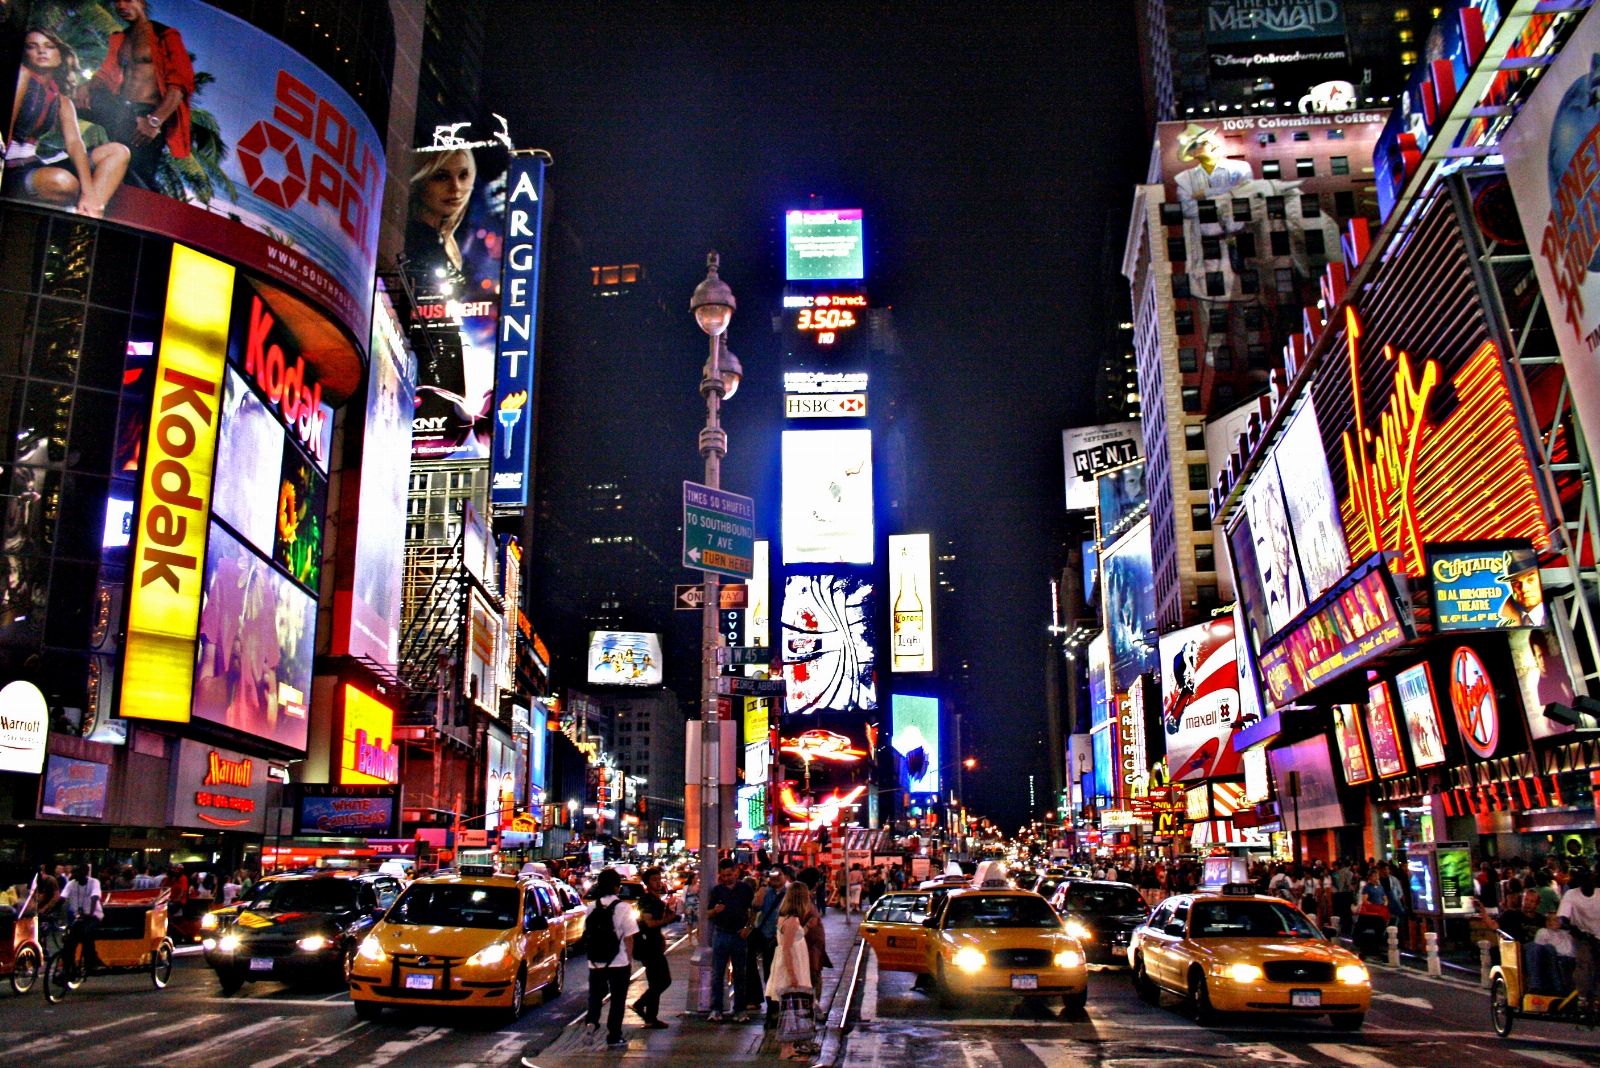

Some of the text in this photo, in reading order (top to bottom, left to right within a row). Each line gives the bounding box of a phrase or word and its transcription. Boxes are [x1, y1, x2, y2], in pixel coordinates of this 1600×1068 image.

[1207, 0, 1338, 31] MERMAID
[1223, 112, 1381, 130] 100% Colombian Coffee
[502, 171, 539, 378] ARGENT
[445, 300, 492, 318] NGHT
[245, 295, 328, 461] Kodak
[788, 399, 835, 413] HSBC
[1075, 443, 1132, 472] RENT
[141, 367, 216, 594] Kodak
[687, 490, 707, 504] TIMES
[710, 496, 719, 508] SQ
[687, 512, 752, 539] TO SOUTHBOUND
[707, 533, 733, 550] 7 AVE
[704, 551, 750, 572] TURN HERE
[1459, 587, 1502, 600] HIRSCHFELD
[1456, 599, 1491, 611] THEATRE
[734, 649, 742, 662] W
[745, 649, 757, 662] 45
[731, 679, 784, 691] GEORGE ABBOTT
[1185, 710, 1217, 729] maxell
[1120, 700, 1134, 785] PALACE
[203, 750, 253, 787] Marriott
[330, 799, 371, 812] WHITE
[317, 809, 387, 831] CHRISTMAS
